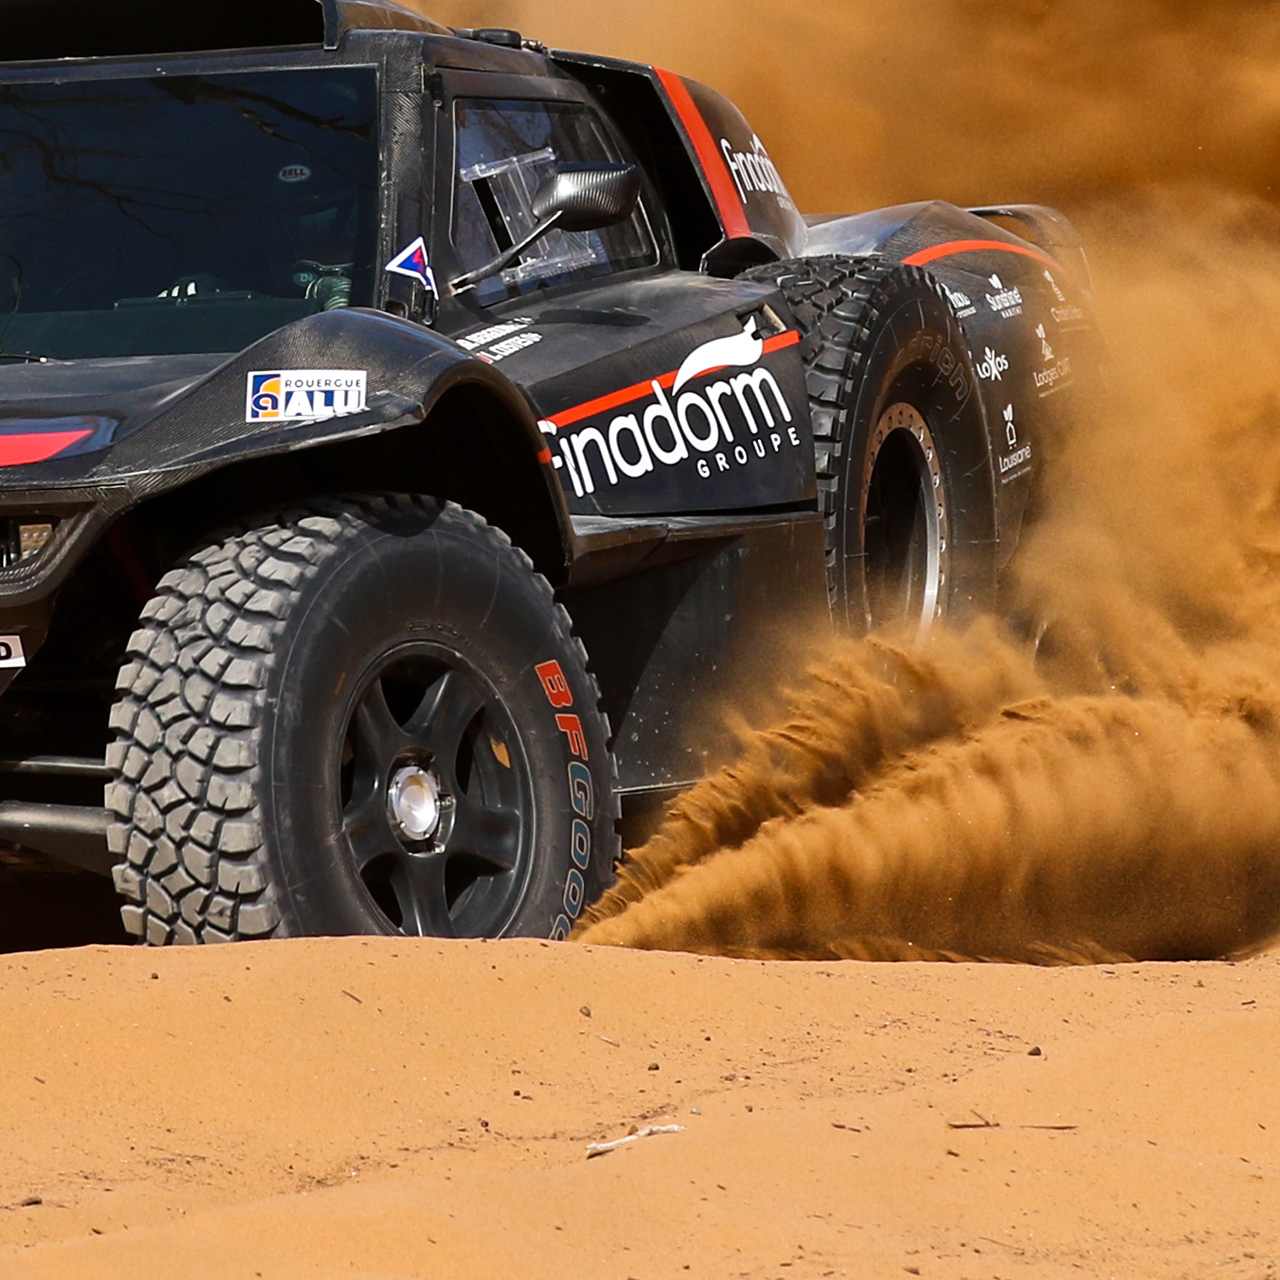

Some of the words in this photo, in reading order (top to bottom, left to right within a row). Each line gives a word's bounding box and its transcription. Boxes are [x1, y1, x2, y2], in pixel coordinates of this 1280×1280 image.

[282, 168, 306, 177] BELL
[985, 287, 1022, 311] Sunshine
[284, 380, 361, 388] ROUERGUE
[284, 390, 361, 416] ALU
[697, 427, 801, 478] GROUPE
